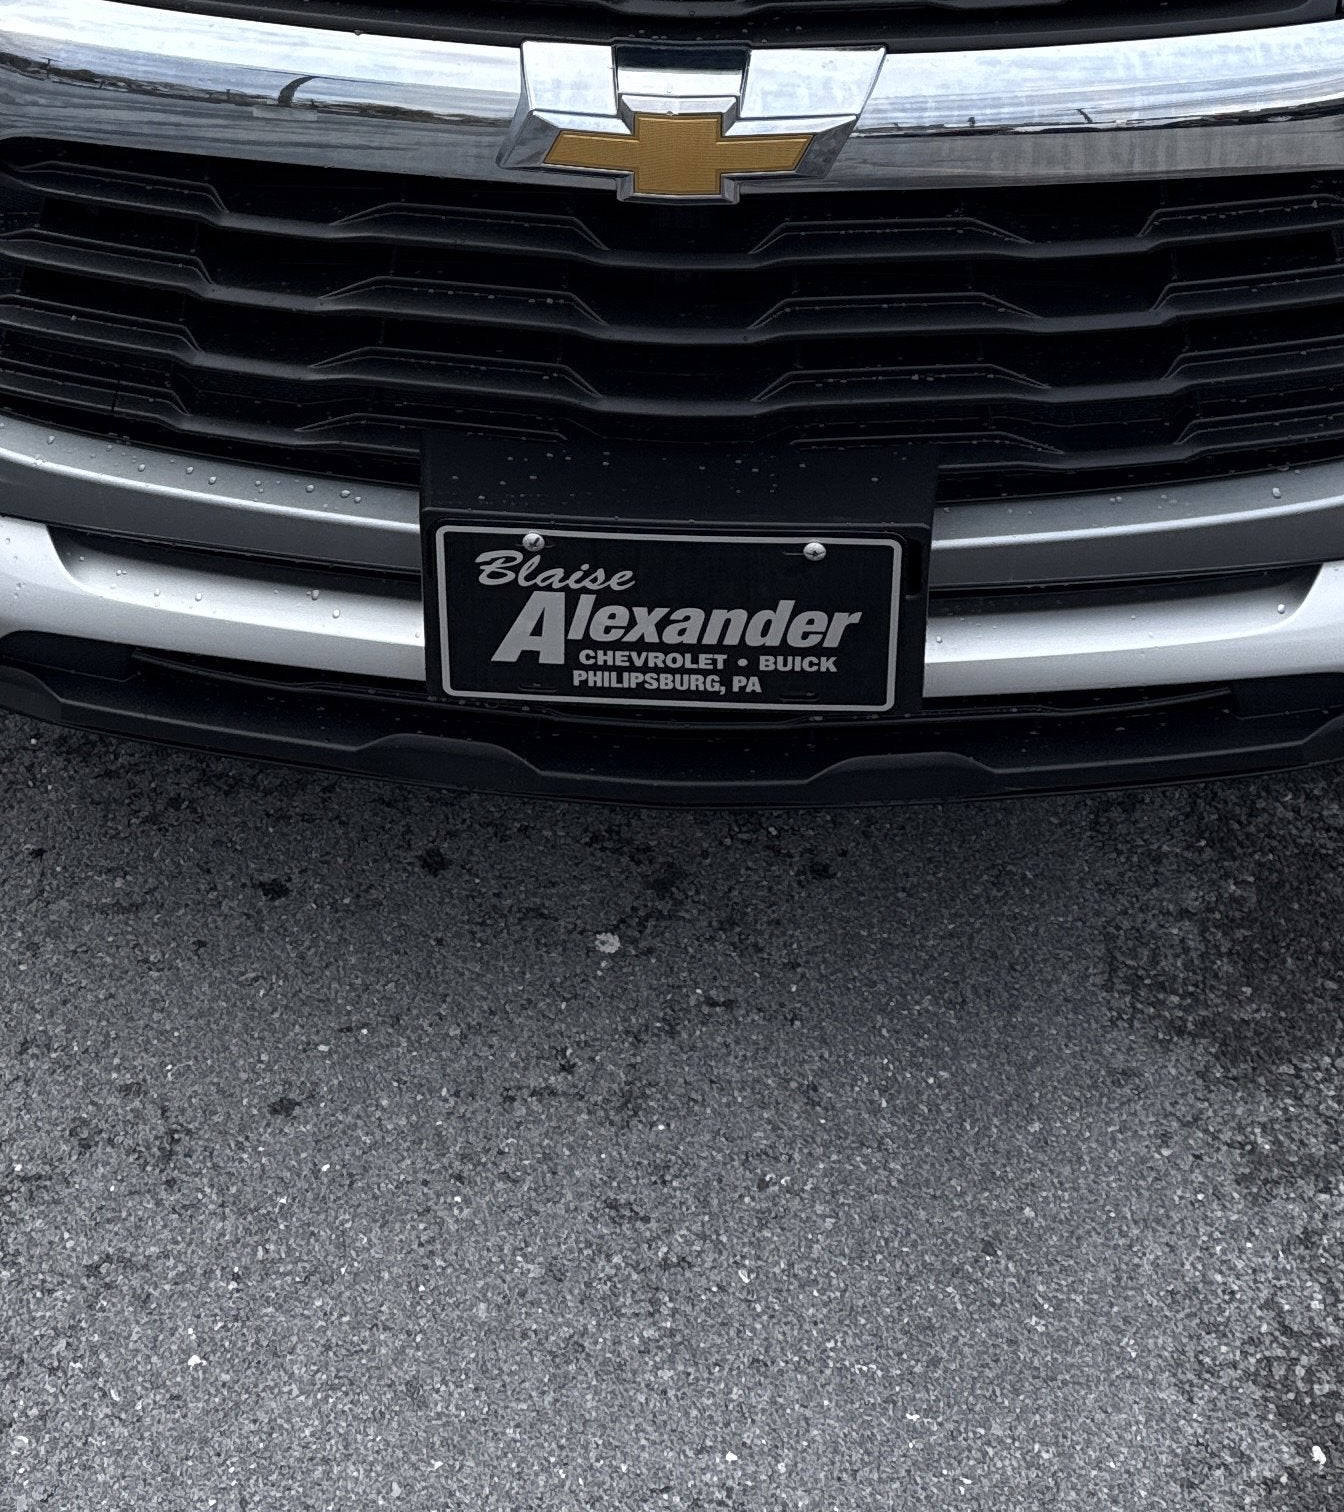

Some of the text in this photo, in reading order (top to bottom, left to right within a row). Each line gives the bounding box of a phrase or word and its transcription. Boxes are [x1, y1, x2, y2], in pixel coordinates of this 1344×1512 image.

[474, 549, 636, 592] Blaise
[490, 590, 862, 666] Alexander
[578, 649, 838, 673] CHEVROLET BUICK
[572, 670, 762, 696] PHILIPSBURG, PA
